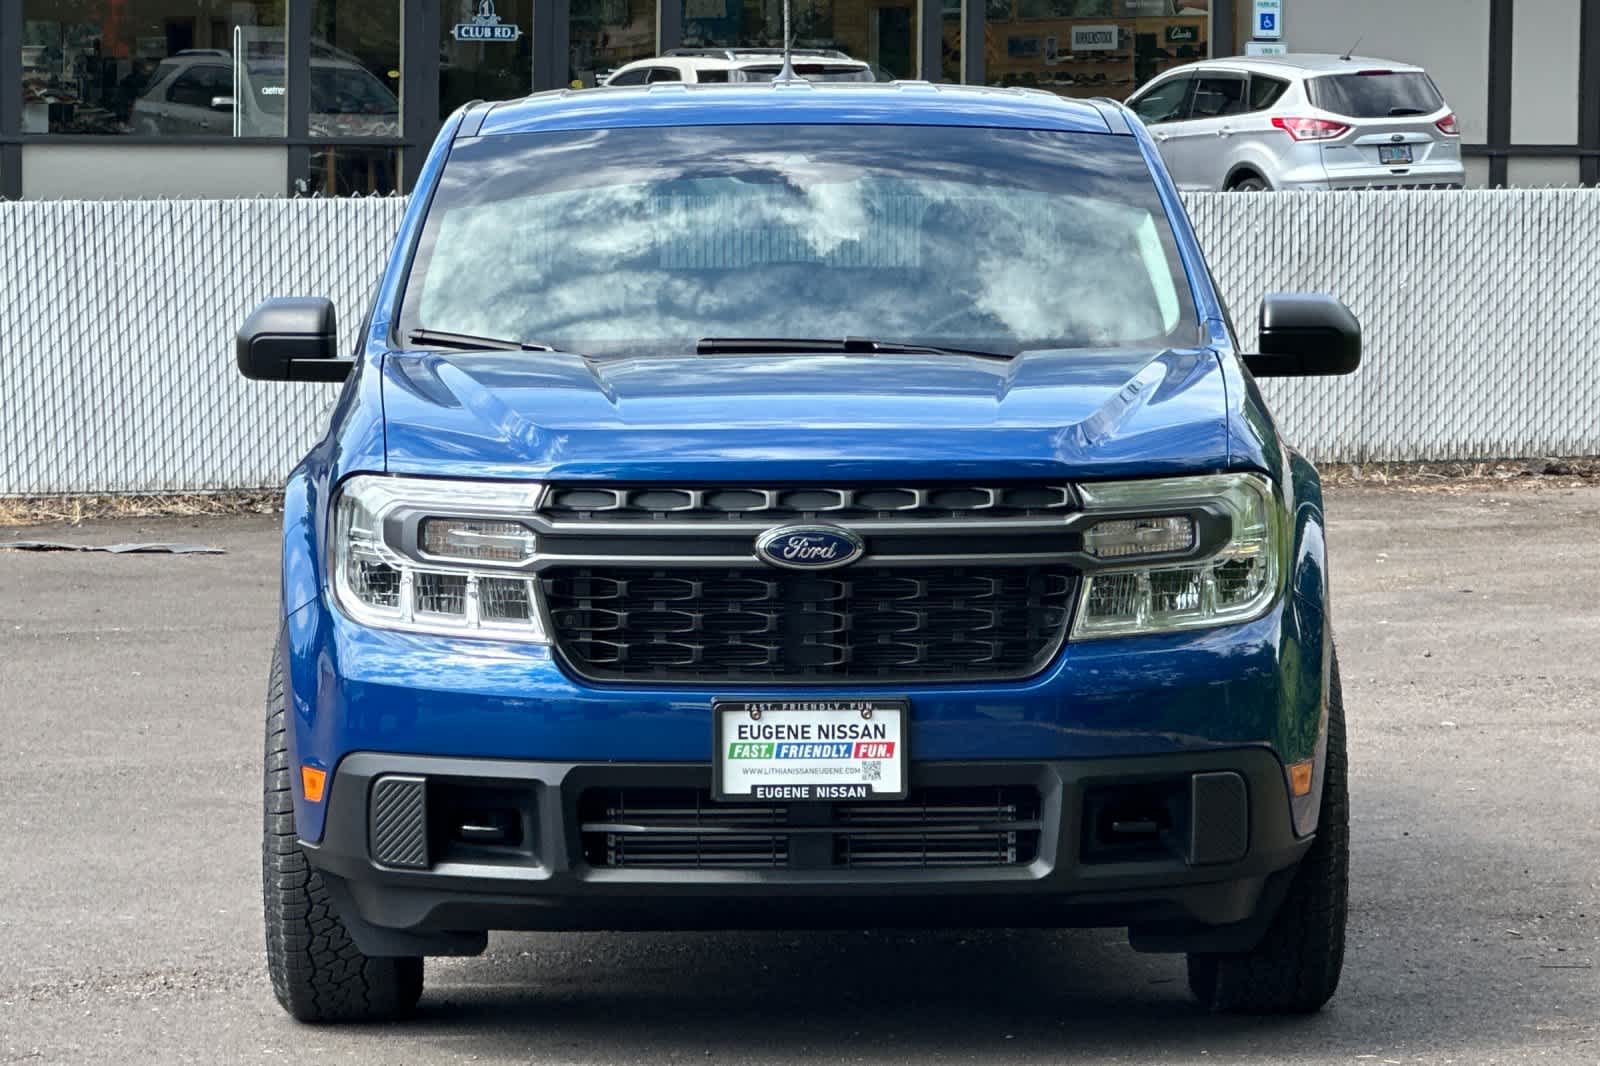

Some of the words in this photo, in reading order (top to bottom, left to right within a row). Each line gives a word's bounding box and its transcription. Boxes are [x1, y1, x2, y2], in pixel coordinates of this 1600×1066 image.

[461, 26, 491, 37] CLUB
[494, 27, 514, 38] RD.
[783, 535, 838, 559] Ford
[738, 724, 811, 740] EUGENE
[818, 723, 886, 740] NISSAN
[733, 744, 771, 758] FAST.
[780, 743, 850, 758] FRIENDLY.
[858, 743, 892, 758] FUN.
[742, 766, 861, 776] WWW.LITHIANISSANEUGENE.COM
[757, 787, 809, 798] EUGENE
[816, 786, 867, 798] NISSAN
